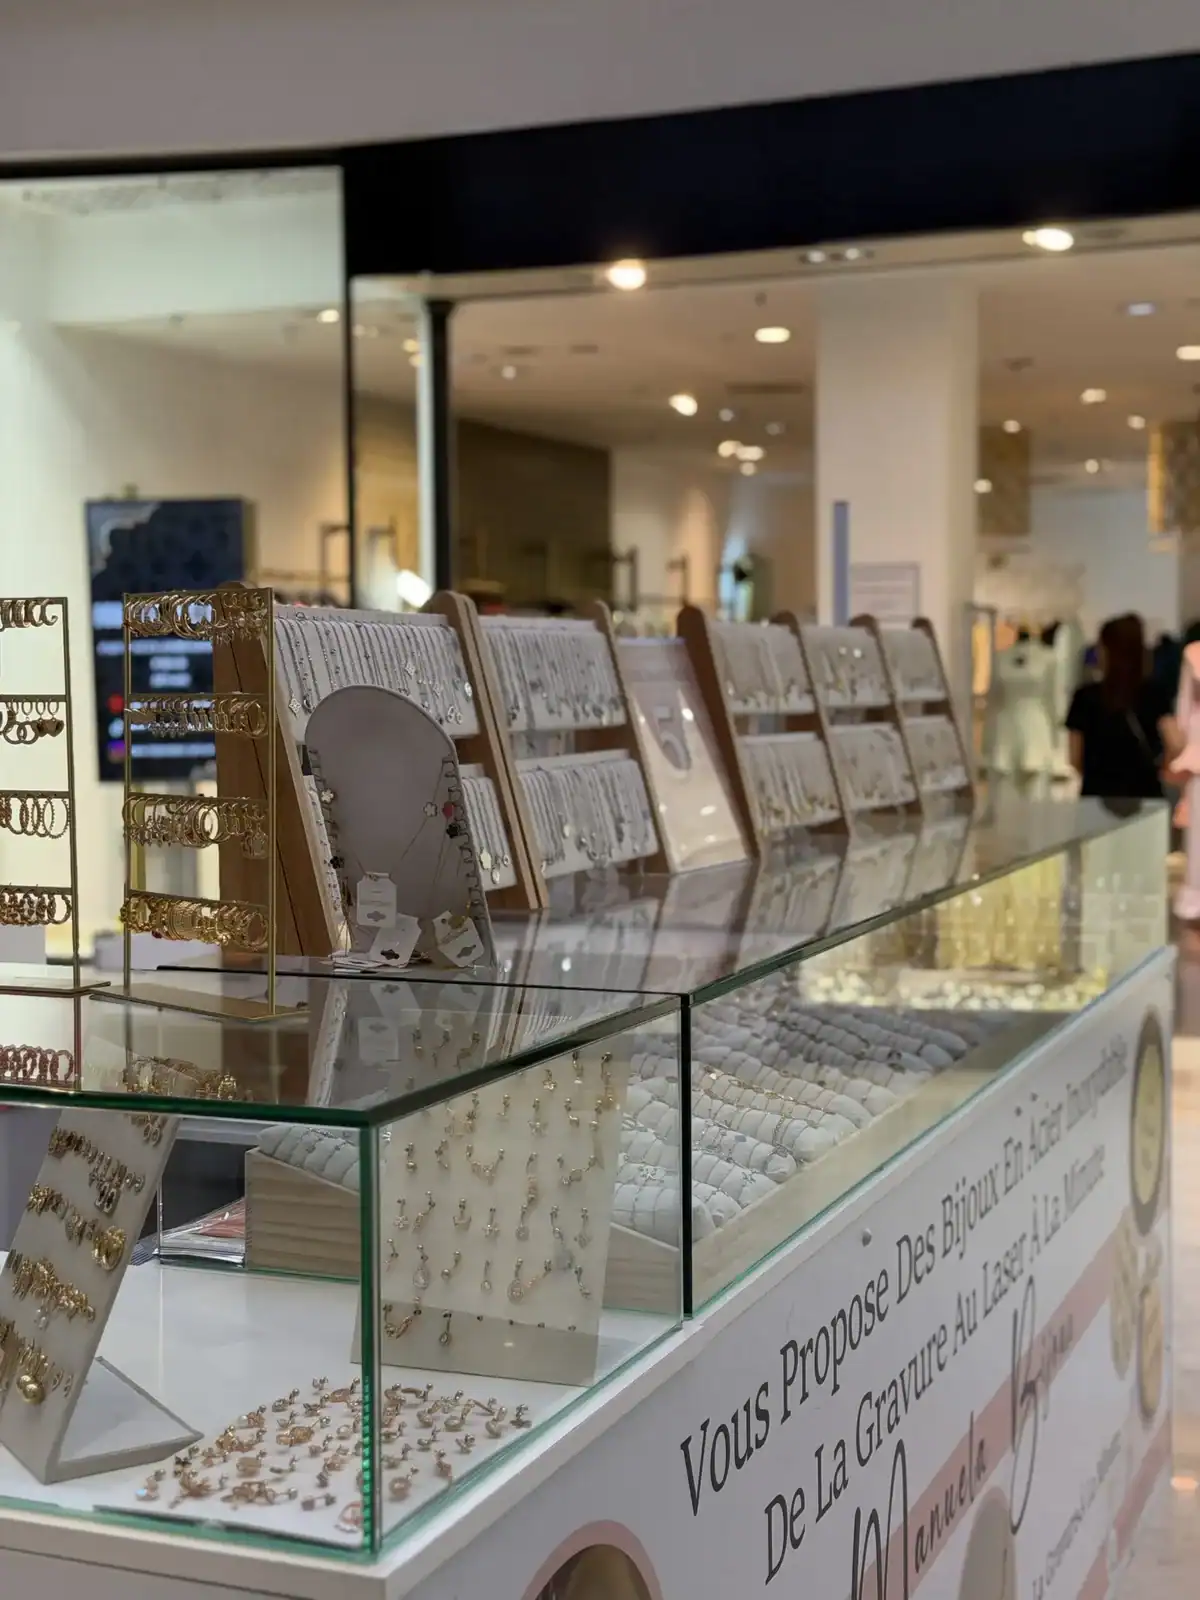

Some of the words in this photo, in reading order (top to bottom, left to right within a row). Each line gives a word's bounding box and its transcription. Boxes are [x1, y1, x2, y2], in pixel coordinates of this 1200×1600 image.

[680, 1381, 770, 1517] Vous
[779, 1268, 889, 1425] Propose
[896, 1223, 936, 1305] Des
[941, 1162, 999, 1261] Bijoux
[1003, 1136, 1024, 1196] En
[764, 1487, 806, 1586] De
[814, 1438, 849, 1524] La
[856, 1323, 950, 1468] Gravure
[953, 1288, 978, 1357] Au
[982, 1231, 1027, 1321] Laser
[1043, 1194, 1062, 1246] La
[850, 1411, 987, 1600] Manuela
